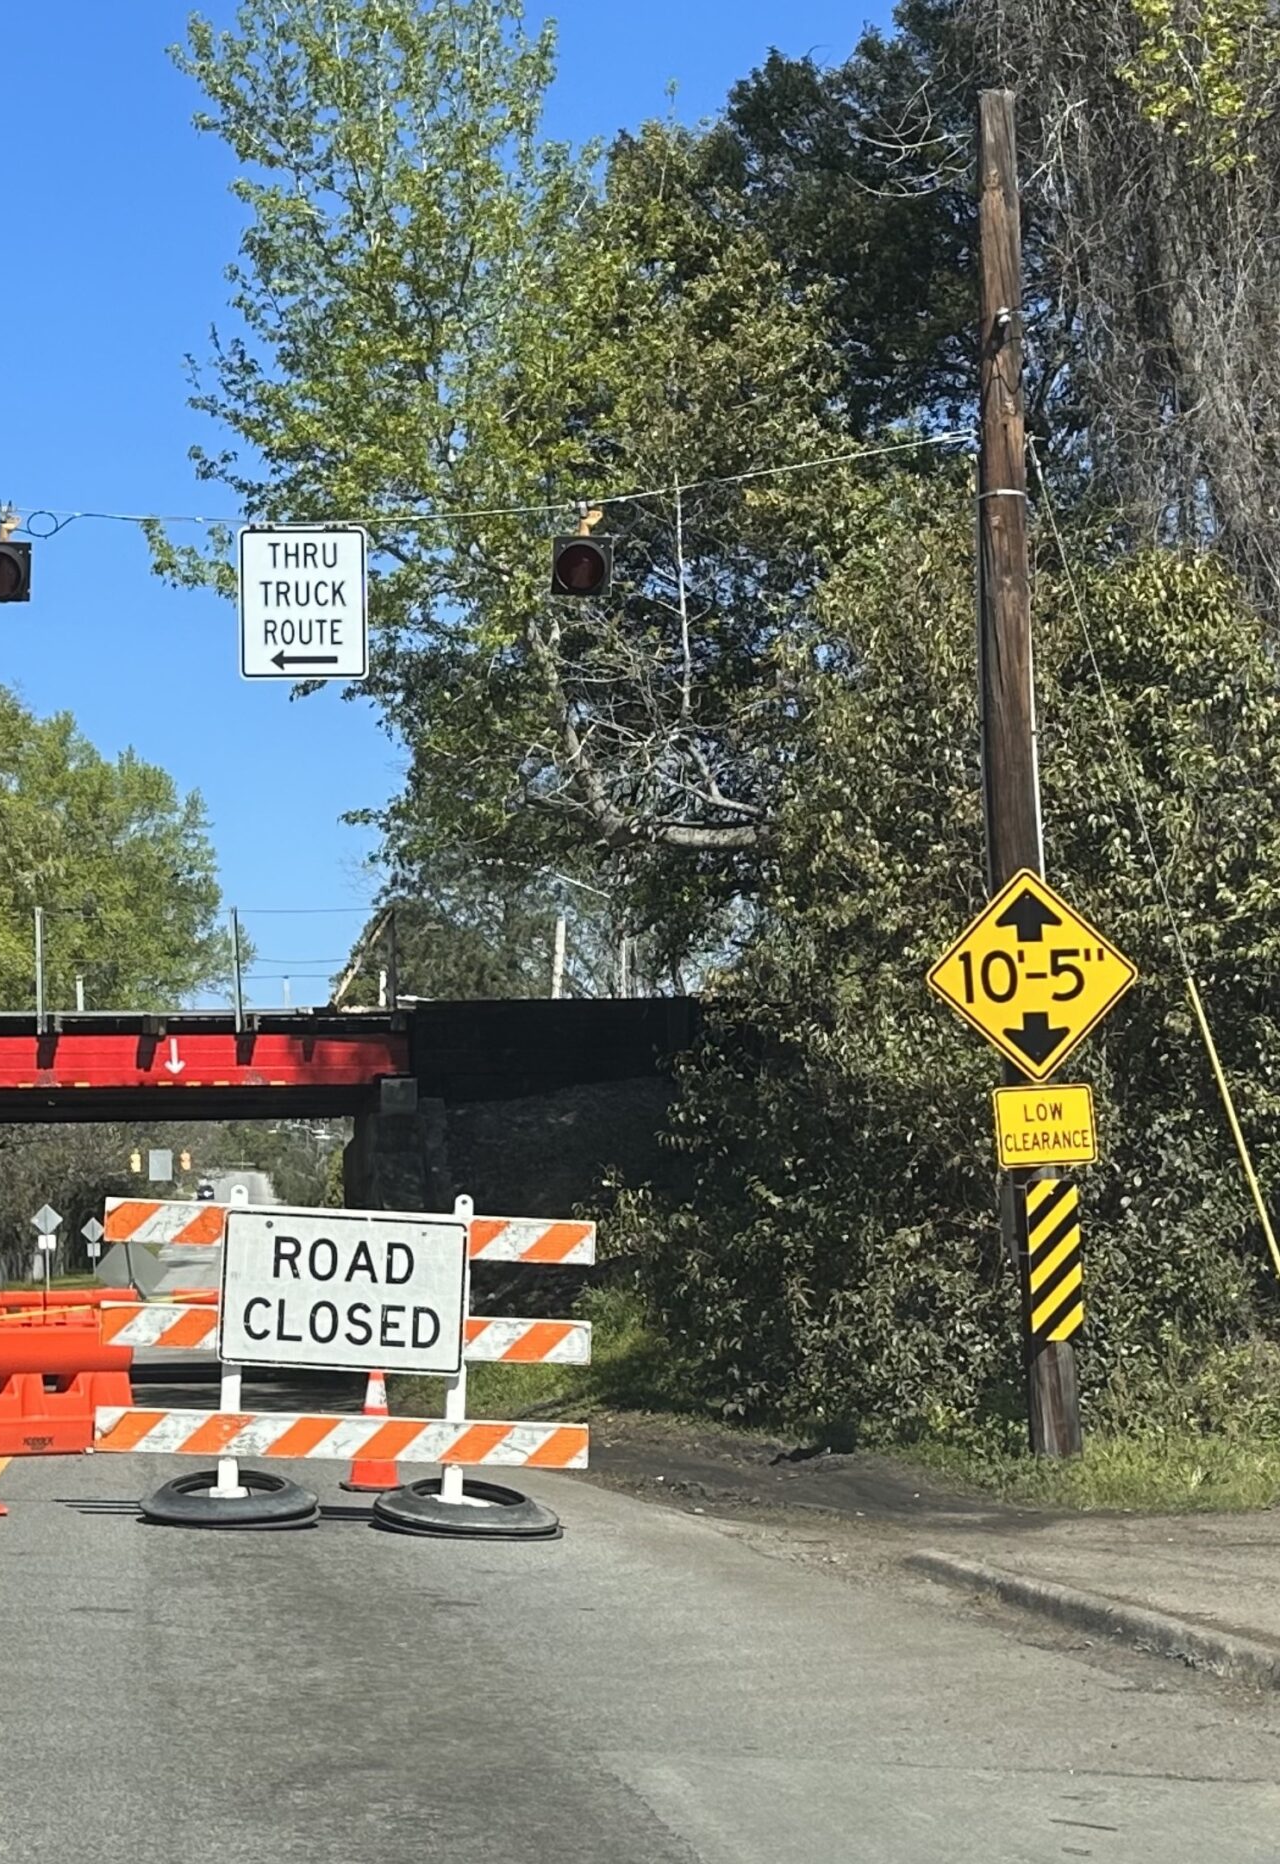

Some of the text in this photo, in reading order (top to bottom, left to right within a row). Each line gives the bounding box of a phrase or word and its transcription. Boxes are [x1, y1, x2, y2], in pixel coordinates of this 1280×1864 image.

[268, 542, 337, 568] THRU
[259, 580, 346, 607] TRUCK
[264, 619, 343, 646] ROUTE
[1023, 1102, 1063, 1122] LOW
[1004, 1129, 1091, 1152] CLEARANCE
[272, 1235, 415, 1285] ROAD
[243, 1297, 441, 1349] CLOSED
